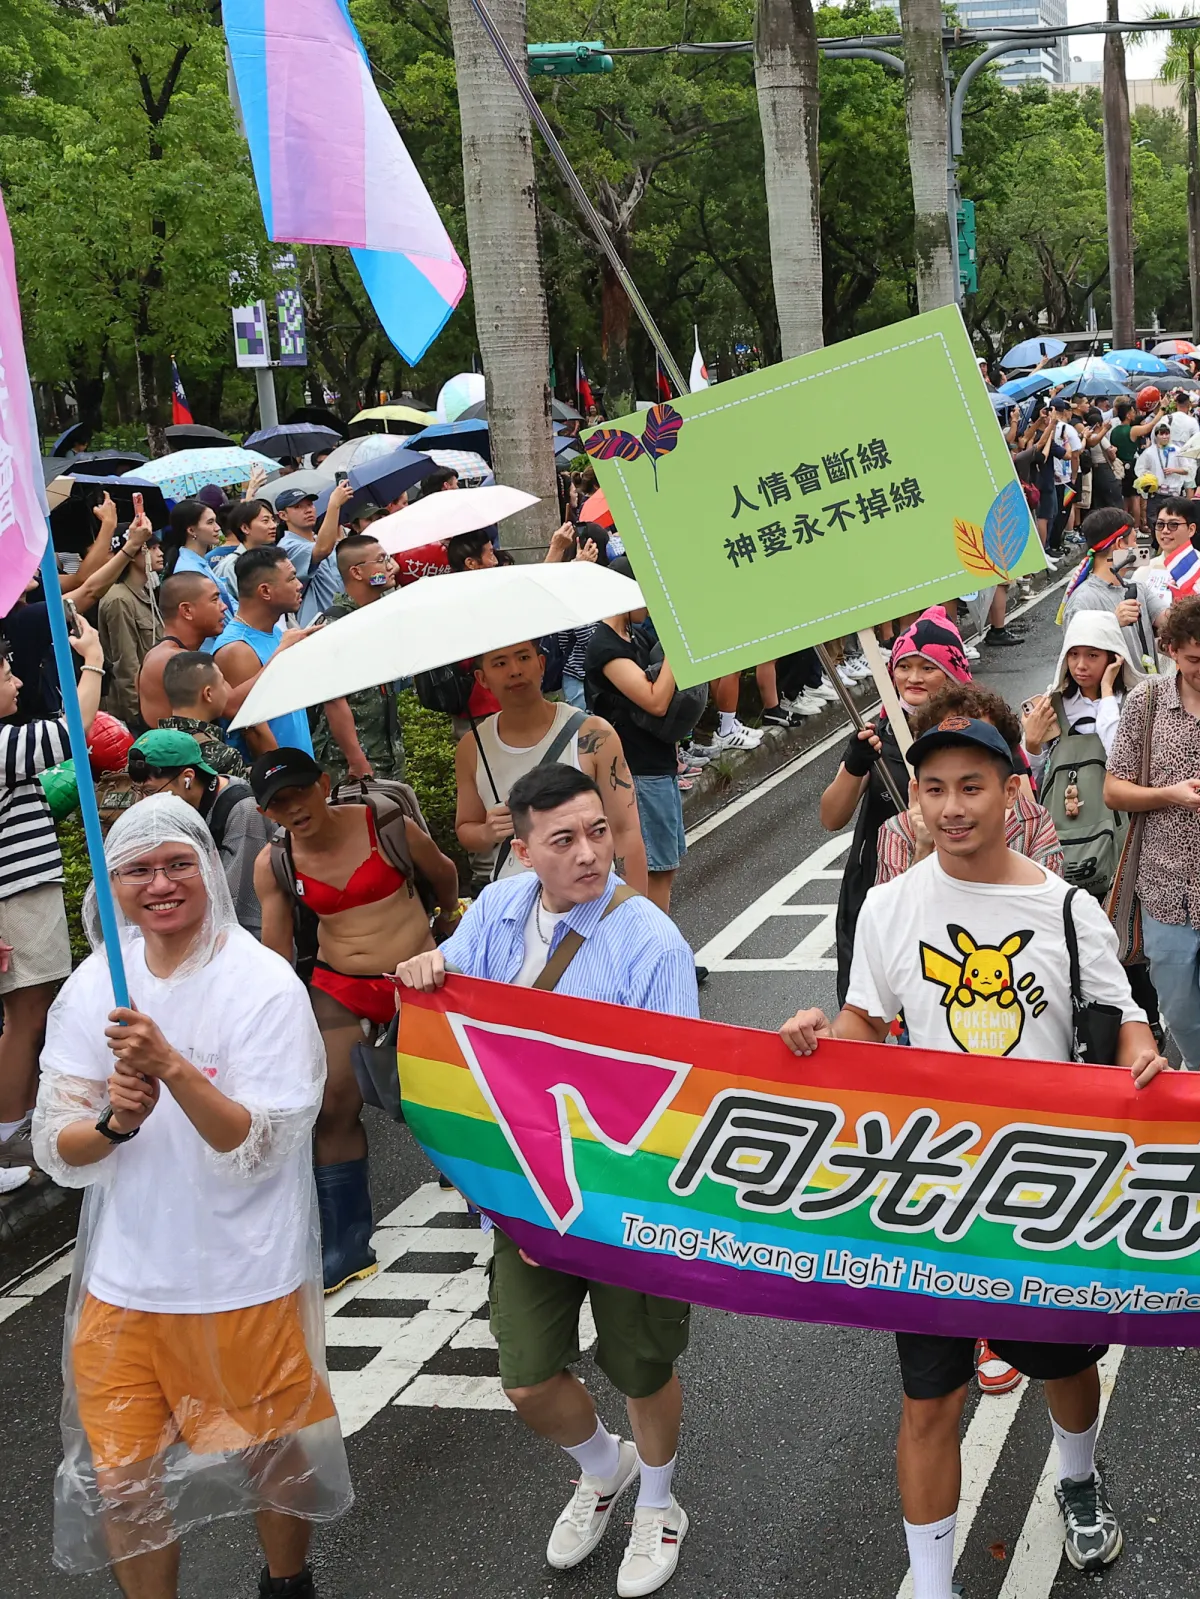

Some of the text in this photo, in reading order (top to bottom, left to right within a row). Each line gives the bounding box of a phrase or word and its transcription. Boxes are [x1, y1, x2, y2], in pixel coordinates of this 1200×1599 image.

[731, 438, 892, 519] 人情會斷線
[723, 477, 925, 568] 神愛永不掉線
[954, 1004, 1016, 1029] POKÉMON
[968, 1031, 1006, 1049] MADE
[623, 1213, 814, 1280] Tong-Kwang
[826, 1251, 905, 1289] Light
[911, 1265, 1012, 1299] House
